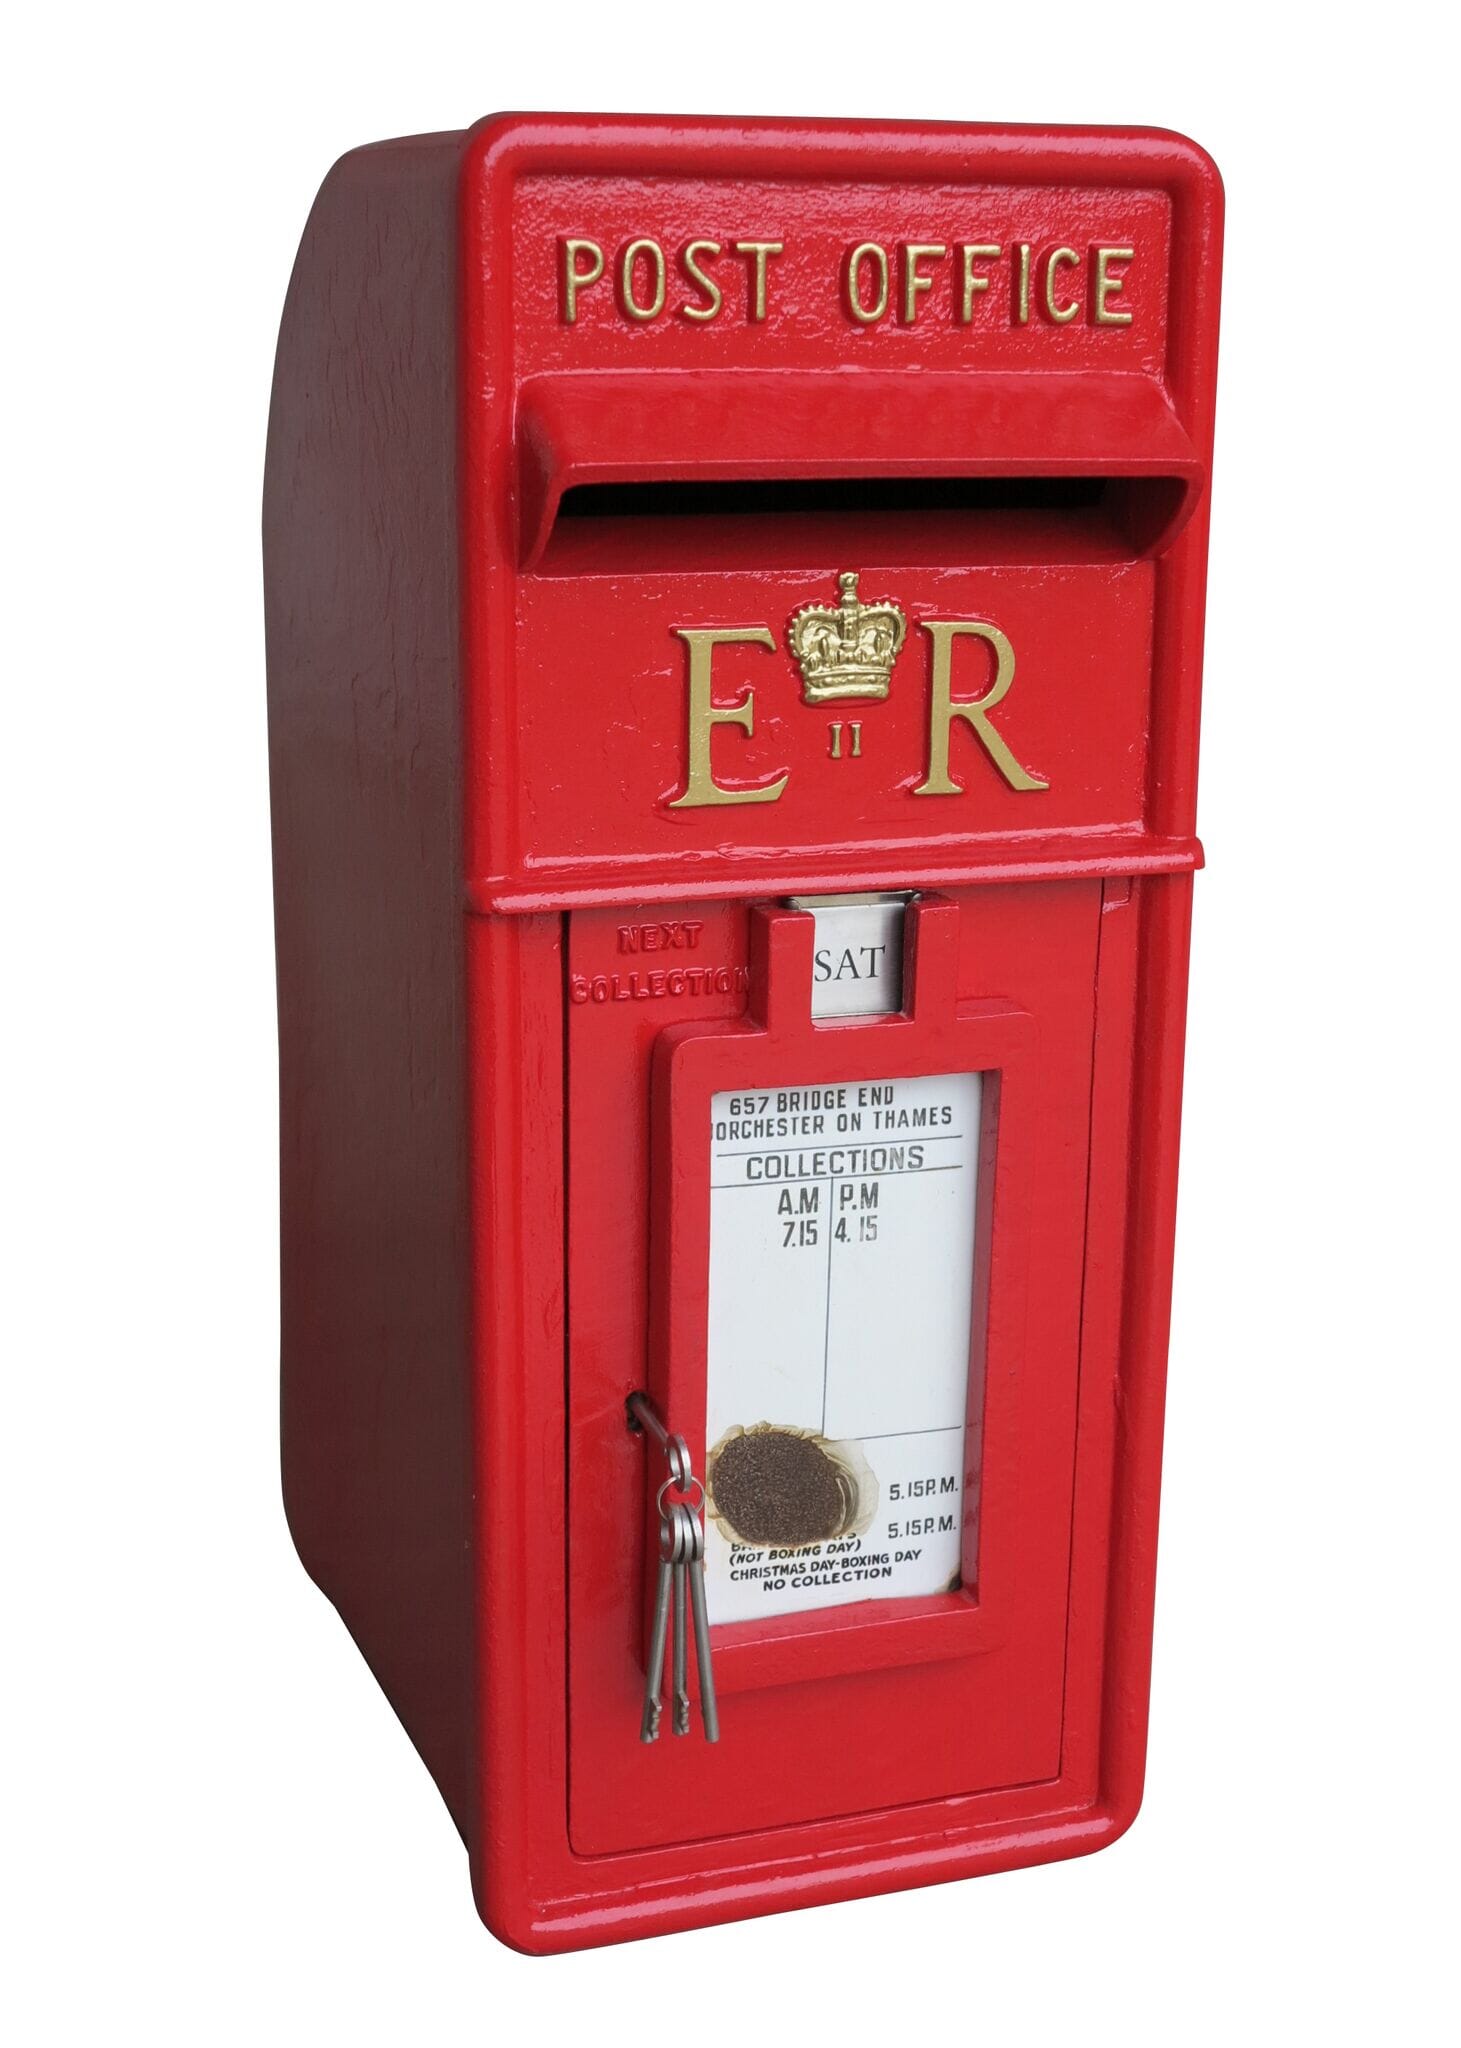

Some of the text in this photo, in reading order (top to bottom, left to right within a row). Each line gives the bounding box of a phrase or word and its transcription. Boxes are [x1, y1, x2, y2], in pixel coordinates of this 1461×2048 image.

[560, 237, 1136, 326] POST OFFICE
[668, 620, 1051, 808] E R
[829, 723, 864, 759] II
[616, 919, 703, 955] NEXT
[813, 945, 887, 982] SAT
[729, 1085, 894, 1116] 657 BRIDGE END
[711, 1105, 953, 1141] ORCHESTER ON THAMES
[746, 1145, 925, 1180] COLLECTIONS
[777, 1182, 879, 1216] A.M P.M
[782, 1219, 818, 1248] 7.15
[729, 1552, 764, 1567] (NOT
[768, 1545, 821, 1561] BOXING
[826, 1539, 862, 1555] DAY)
[730, 1562, 806, 1582] CHRISTMAS
[894, 1549, 923, 1563] DAY
[763, 1566, 892, 1592] NO COLLECTION
